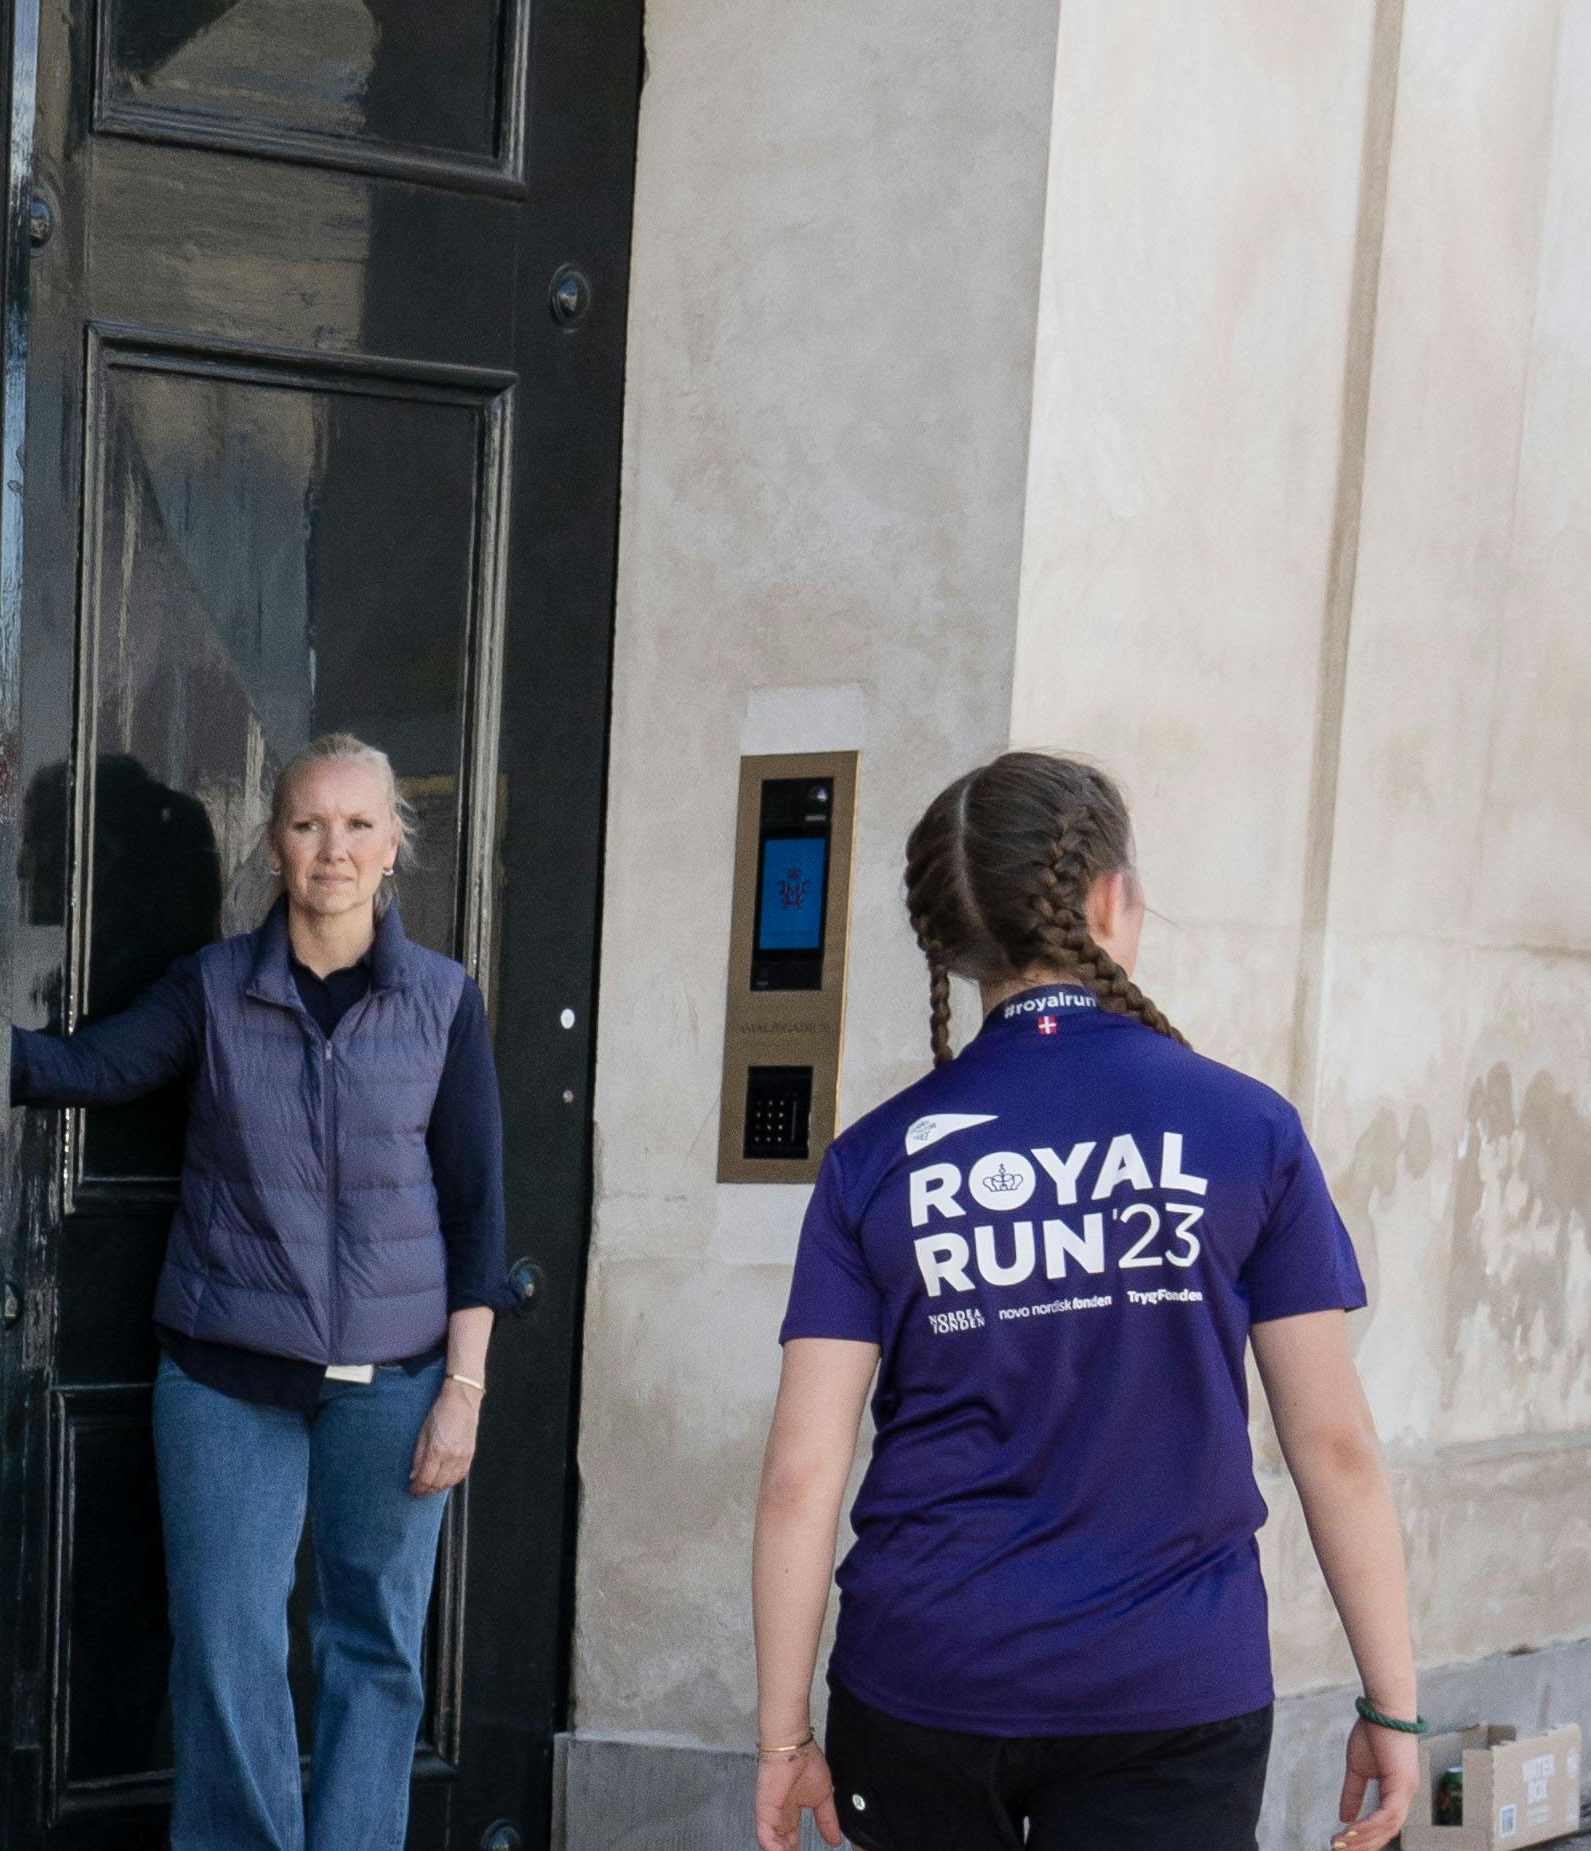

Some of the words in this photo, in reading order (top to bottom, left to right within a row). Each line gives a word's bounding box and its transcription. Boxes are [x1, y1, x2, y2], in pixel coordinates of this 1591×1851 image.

[1003, 991, 1096, 1019] #royalrun
[909, 1132, 1208, 1227] ROYAL
[998, 1306, 1030, 1320] novo
